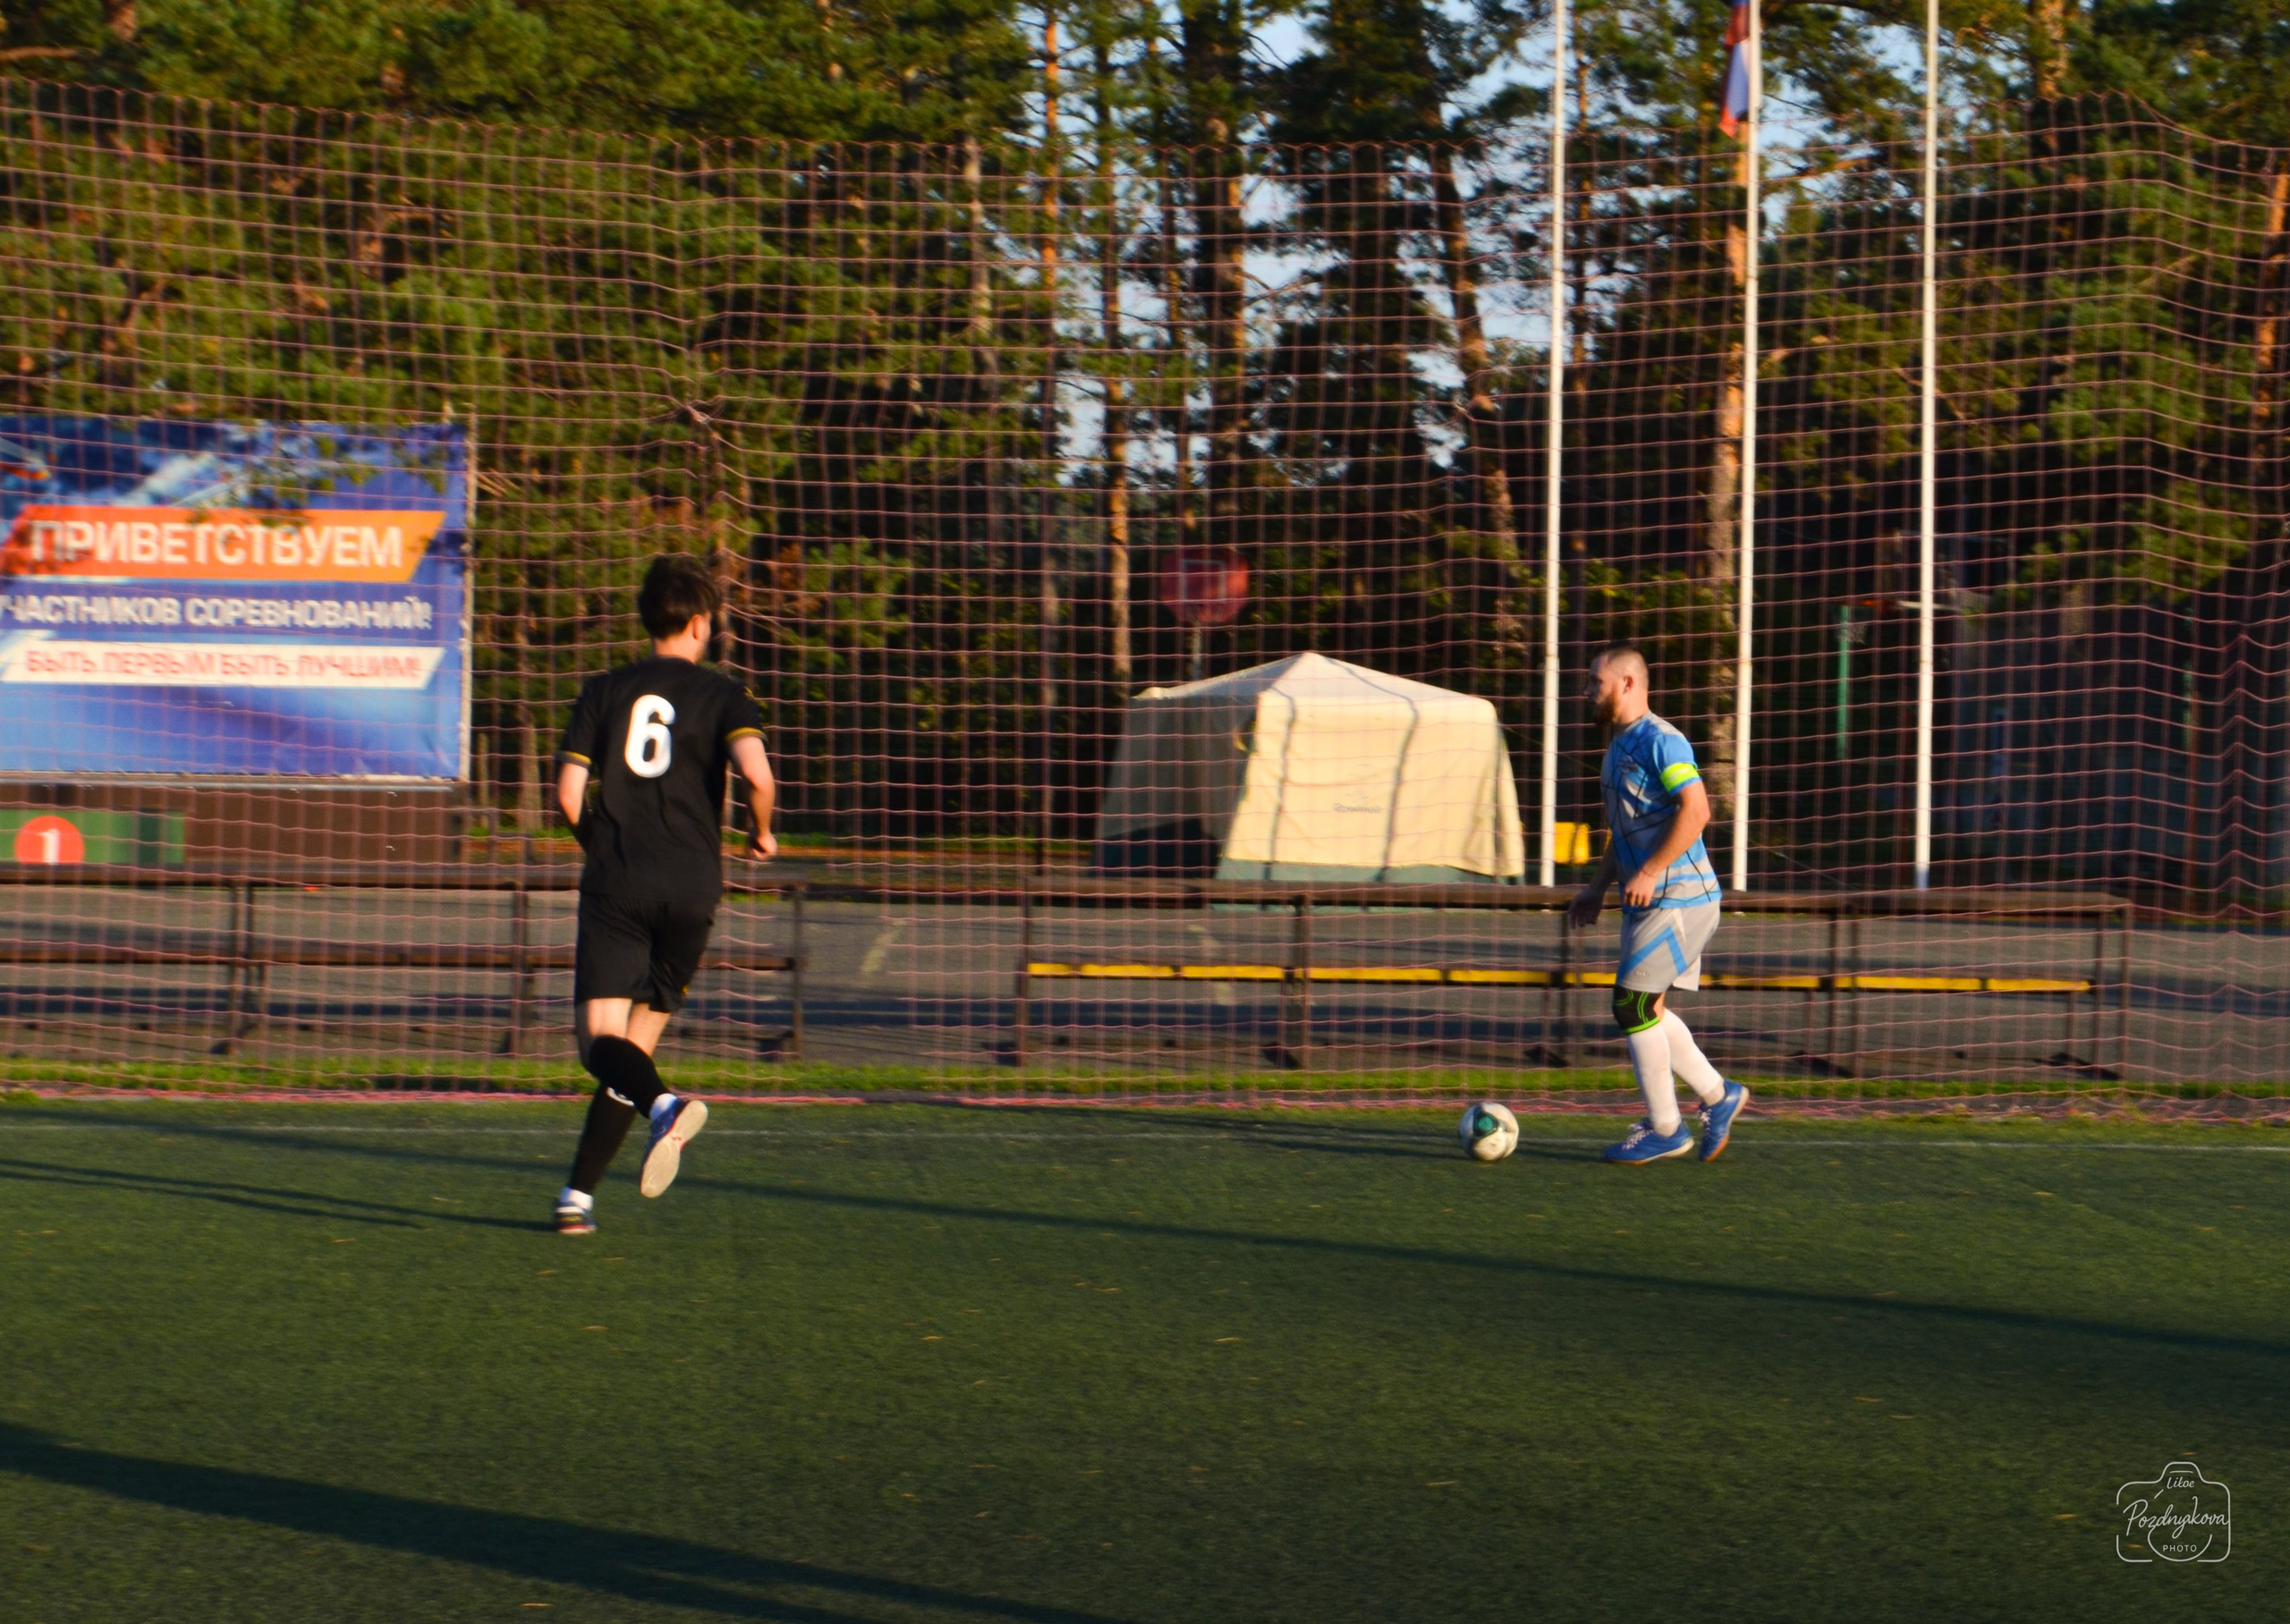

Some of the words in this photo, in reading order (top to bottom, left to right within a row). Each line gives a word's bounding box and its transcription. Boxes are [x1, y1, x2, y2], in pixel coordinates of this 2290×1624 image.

[30, 520, 403, 568] ПРИВЕТСТВУЕМ
[26, 649, 96, 672] БЫТЬ
[219, 653, 291, 677] БЫТЬ
[624, 694, 675, 778] 6
[38, 828, 61, 865] 1
